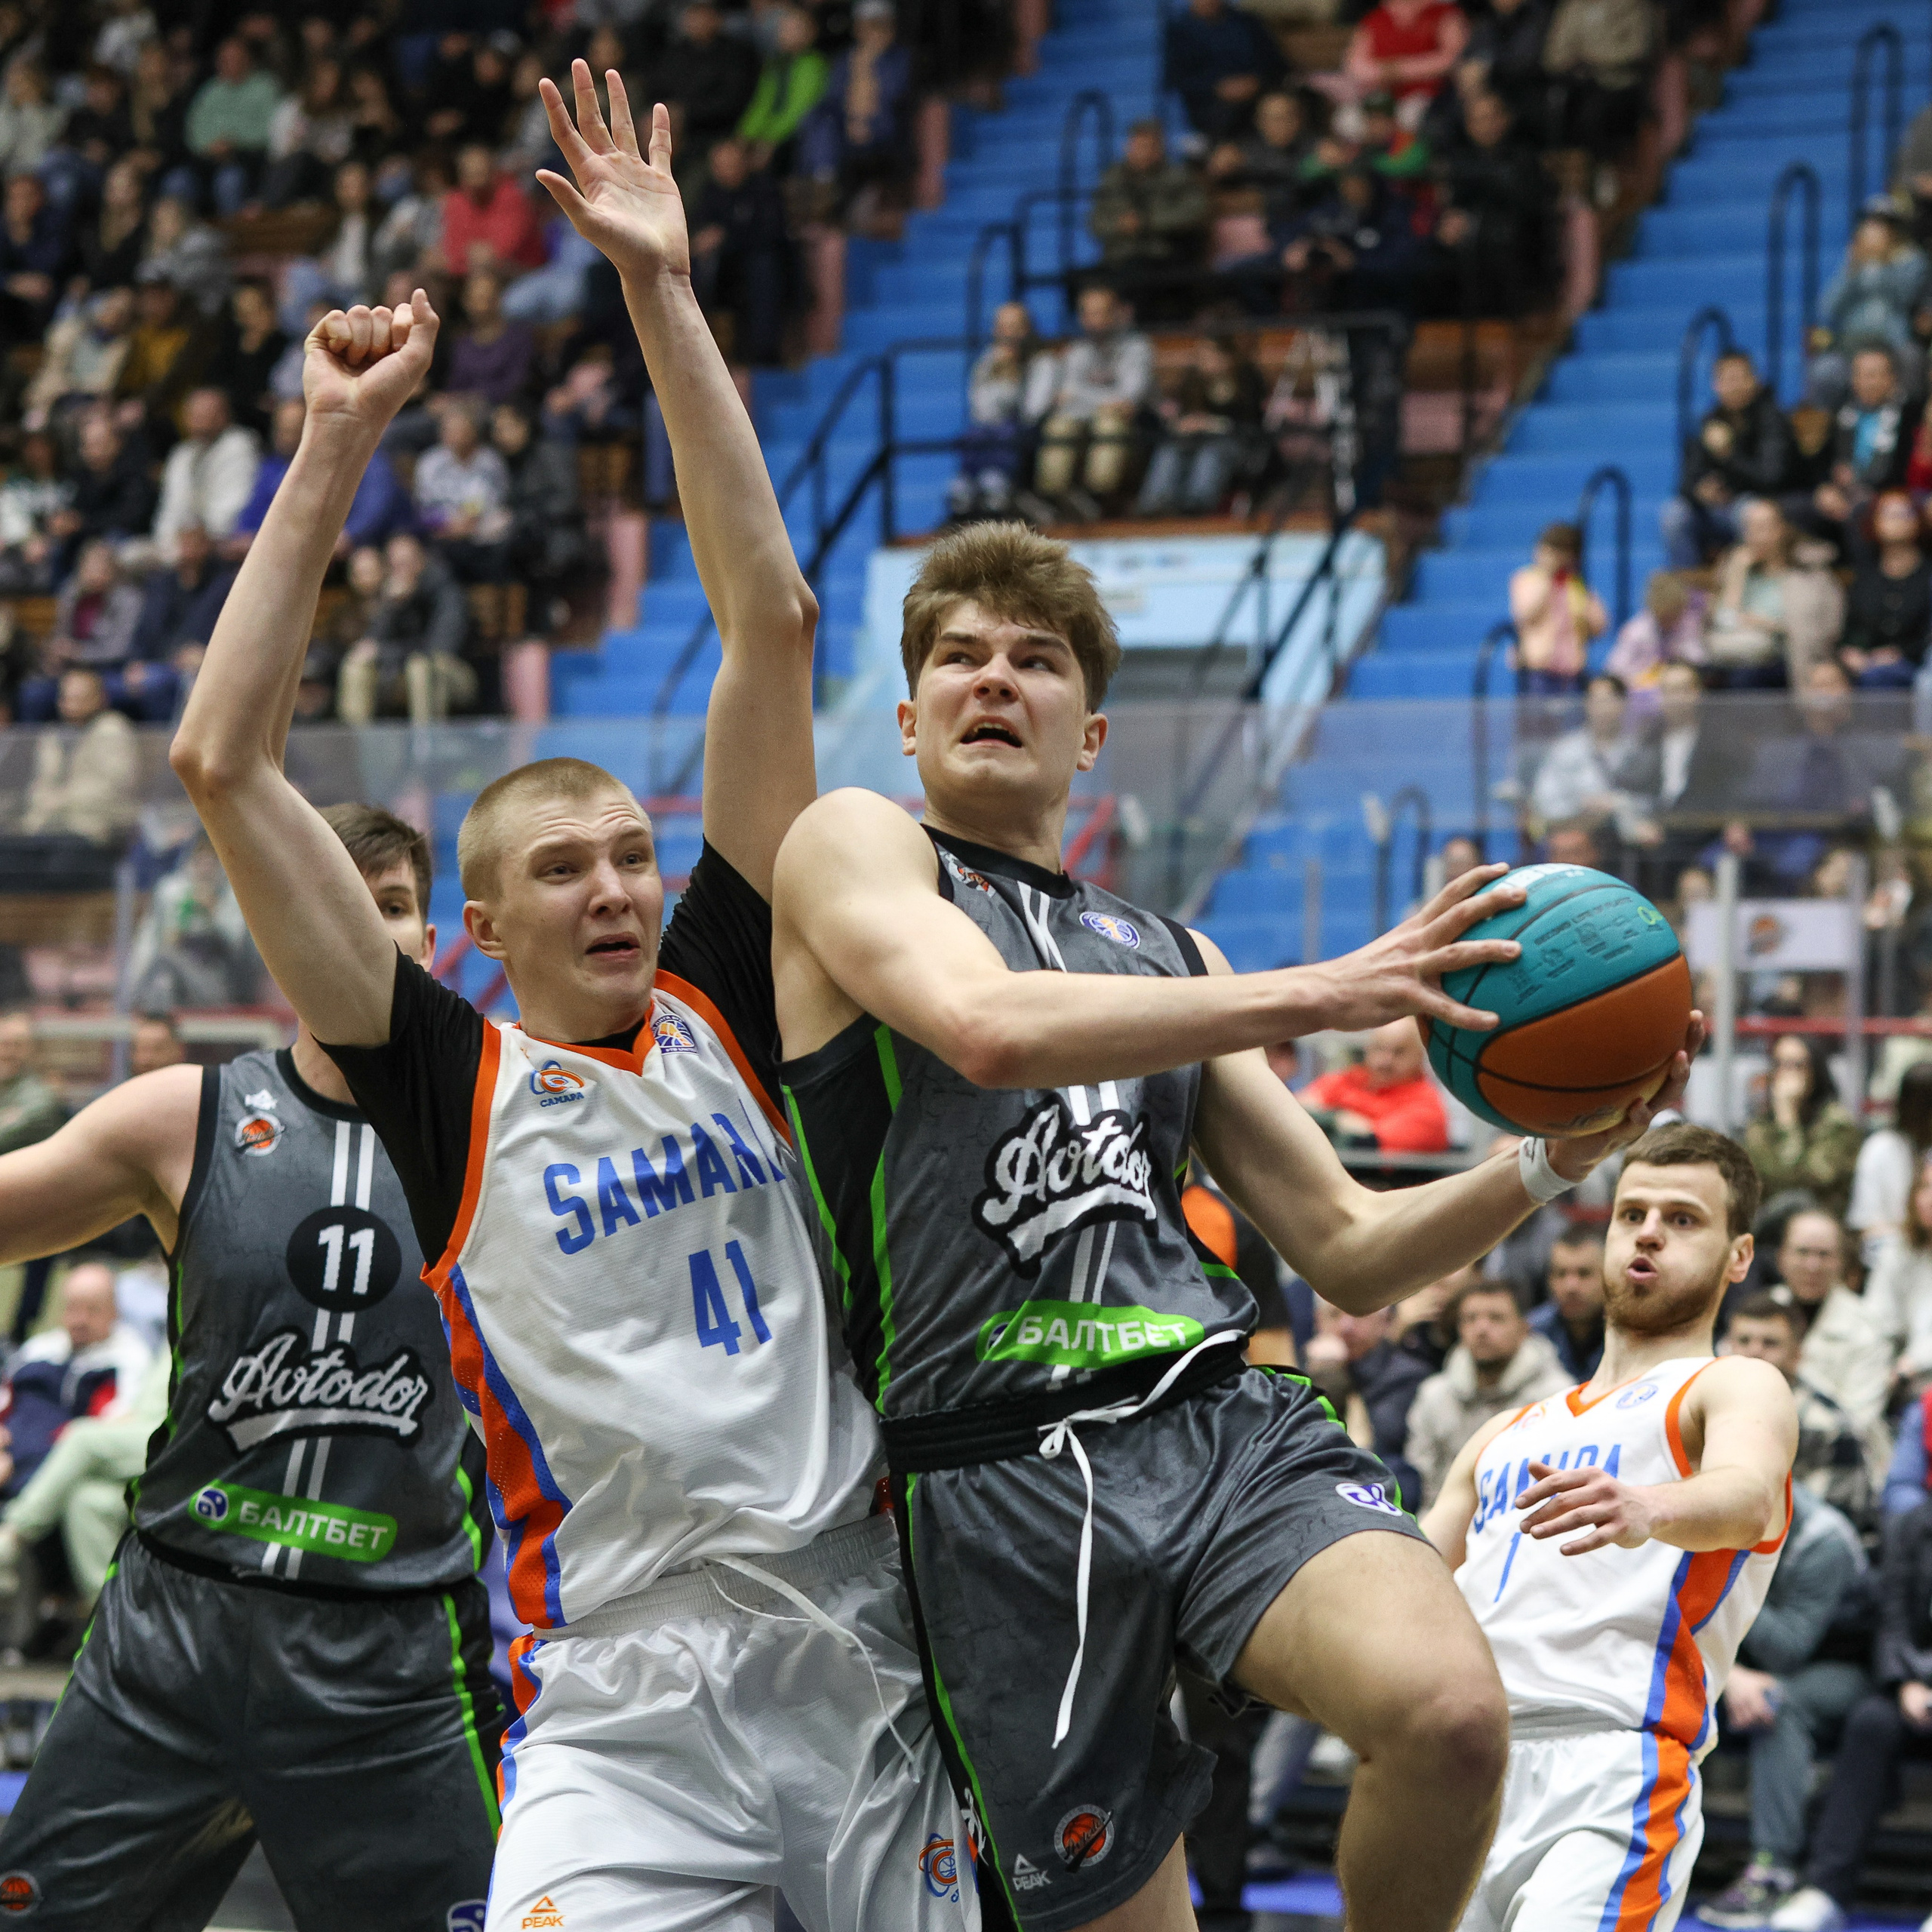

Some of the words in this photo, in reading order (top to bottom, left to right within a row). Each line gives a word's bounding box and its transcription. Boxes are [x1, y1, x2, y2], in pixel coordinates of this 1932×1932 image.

[318, 1224, 375, 1295] 11
[688, 1239, 773, 1356] 41
[1016, 1315, 1189, 1353] БАЛТБЕТ
[208, 1333, 429, 1443] Avtodor
[1473, 1444, 1622, 1535] SAMA
[238, 1500, 389, 1551] БАЛТБЕТ
[1494, 1531, 1523, 1604] 1
[1012, 1869, 1053, 1892] PEAK
[521, 1915, 565, 1930] PEAK
